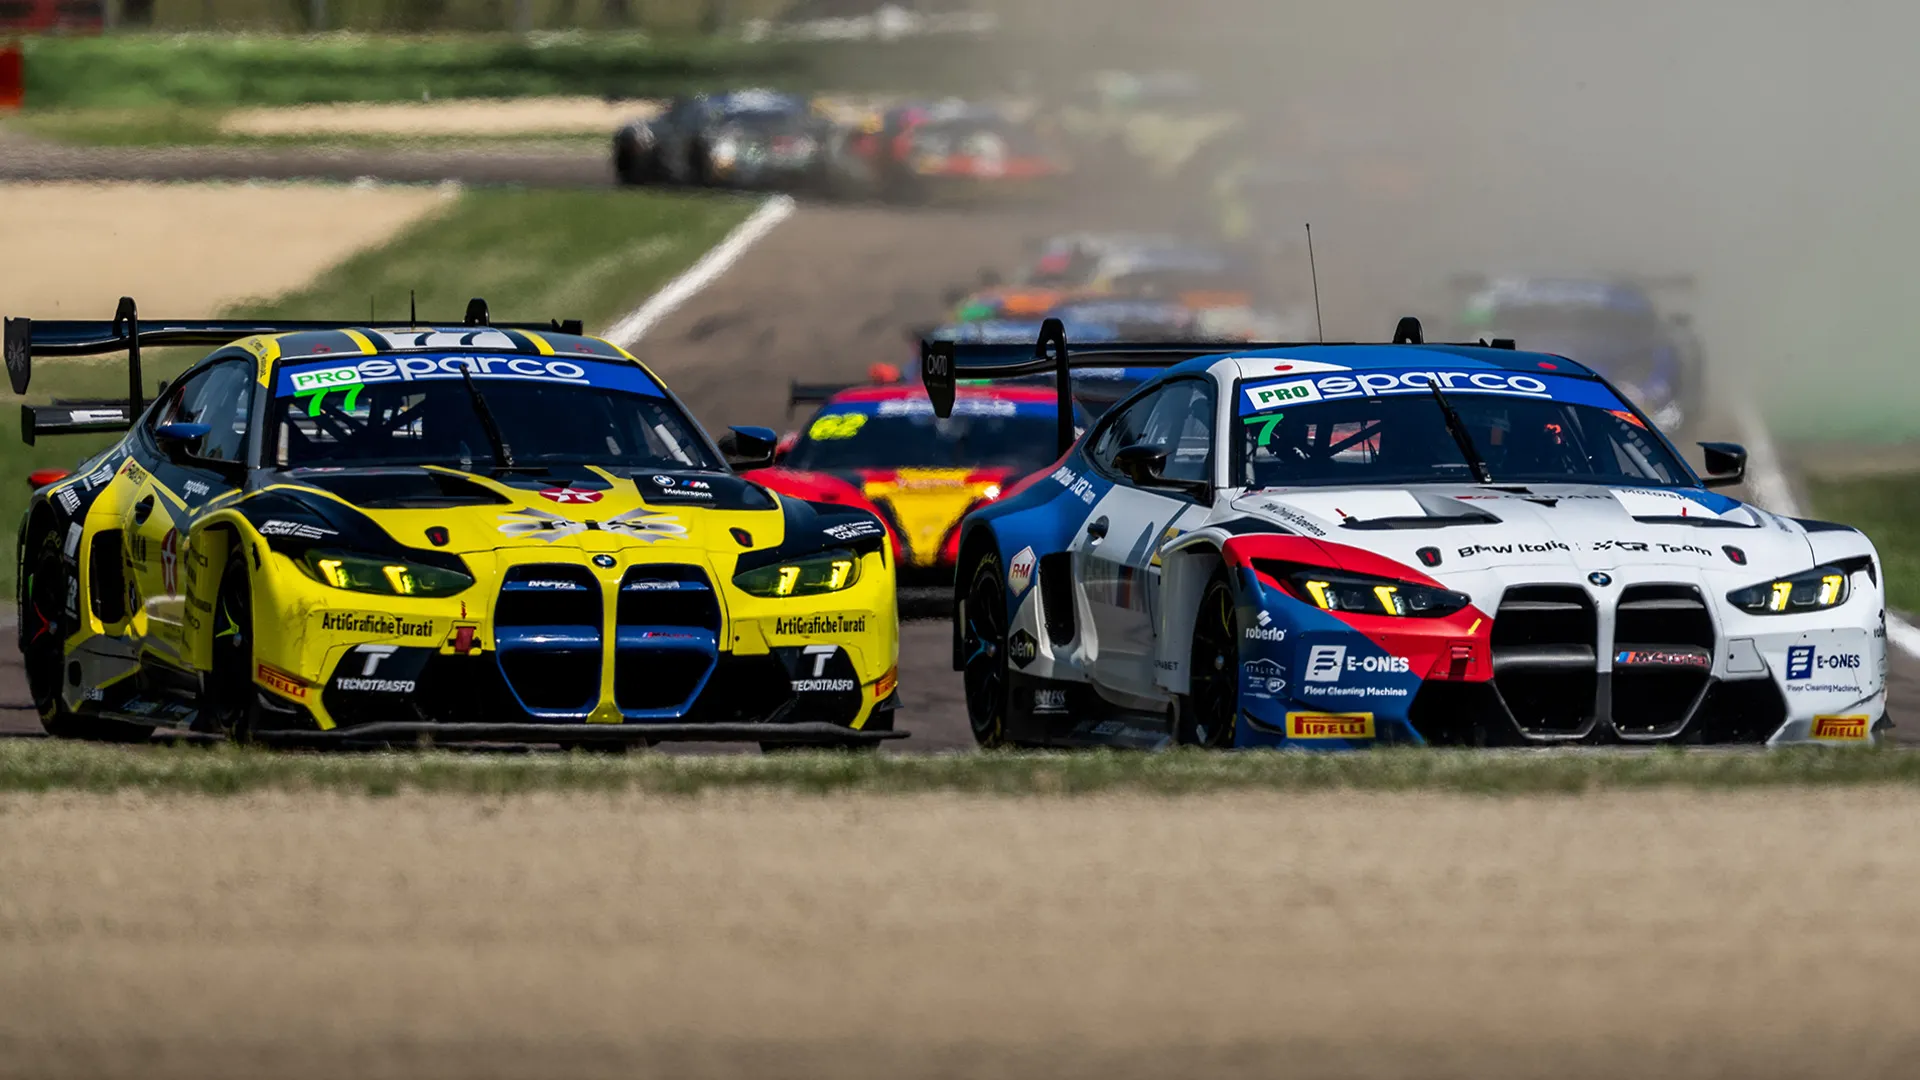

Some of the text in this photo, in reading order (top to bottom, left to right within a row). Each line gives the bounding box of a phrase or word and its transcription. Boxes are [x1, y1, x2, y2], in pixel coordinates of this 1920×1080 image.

[297, 369, 356, 386] PRO
[357, 357, 585, 381] sparco
[1317, 371, 1547, 396] sparco
[293, 383, 366, 417] 77
[1258, 386, 1310, 403] PRO
[1243, 413, 1284, 446] 7
[663, 487, 713, 499] Motorsport
[1457, 544, 1513, 558] BMW
[1517, 540, 1571, 553] Italia
[1655, 543, 1713, 556] Team
[1346, 655, 1410, 673] E-ONES
[1817, 654, 1860, 669] E-ONES
[336, 677, 416, 693] TECNOTRASFO
[790, 679, 854, 691] TECNOTRASFO
[1304, 685, 1408, 698] Floor Cleaning Machines
[1805, 683, 1832, 693] Cleaning
[1833, 684, 1860, 692] Machines
[1295, 716, 1365, 734] PIRELLI
[1815, 718, 1865, 737] PIRELLI
